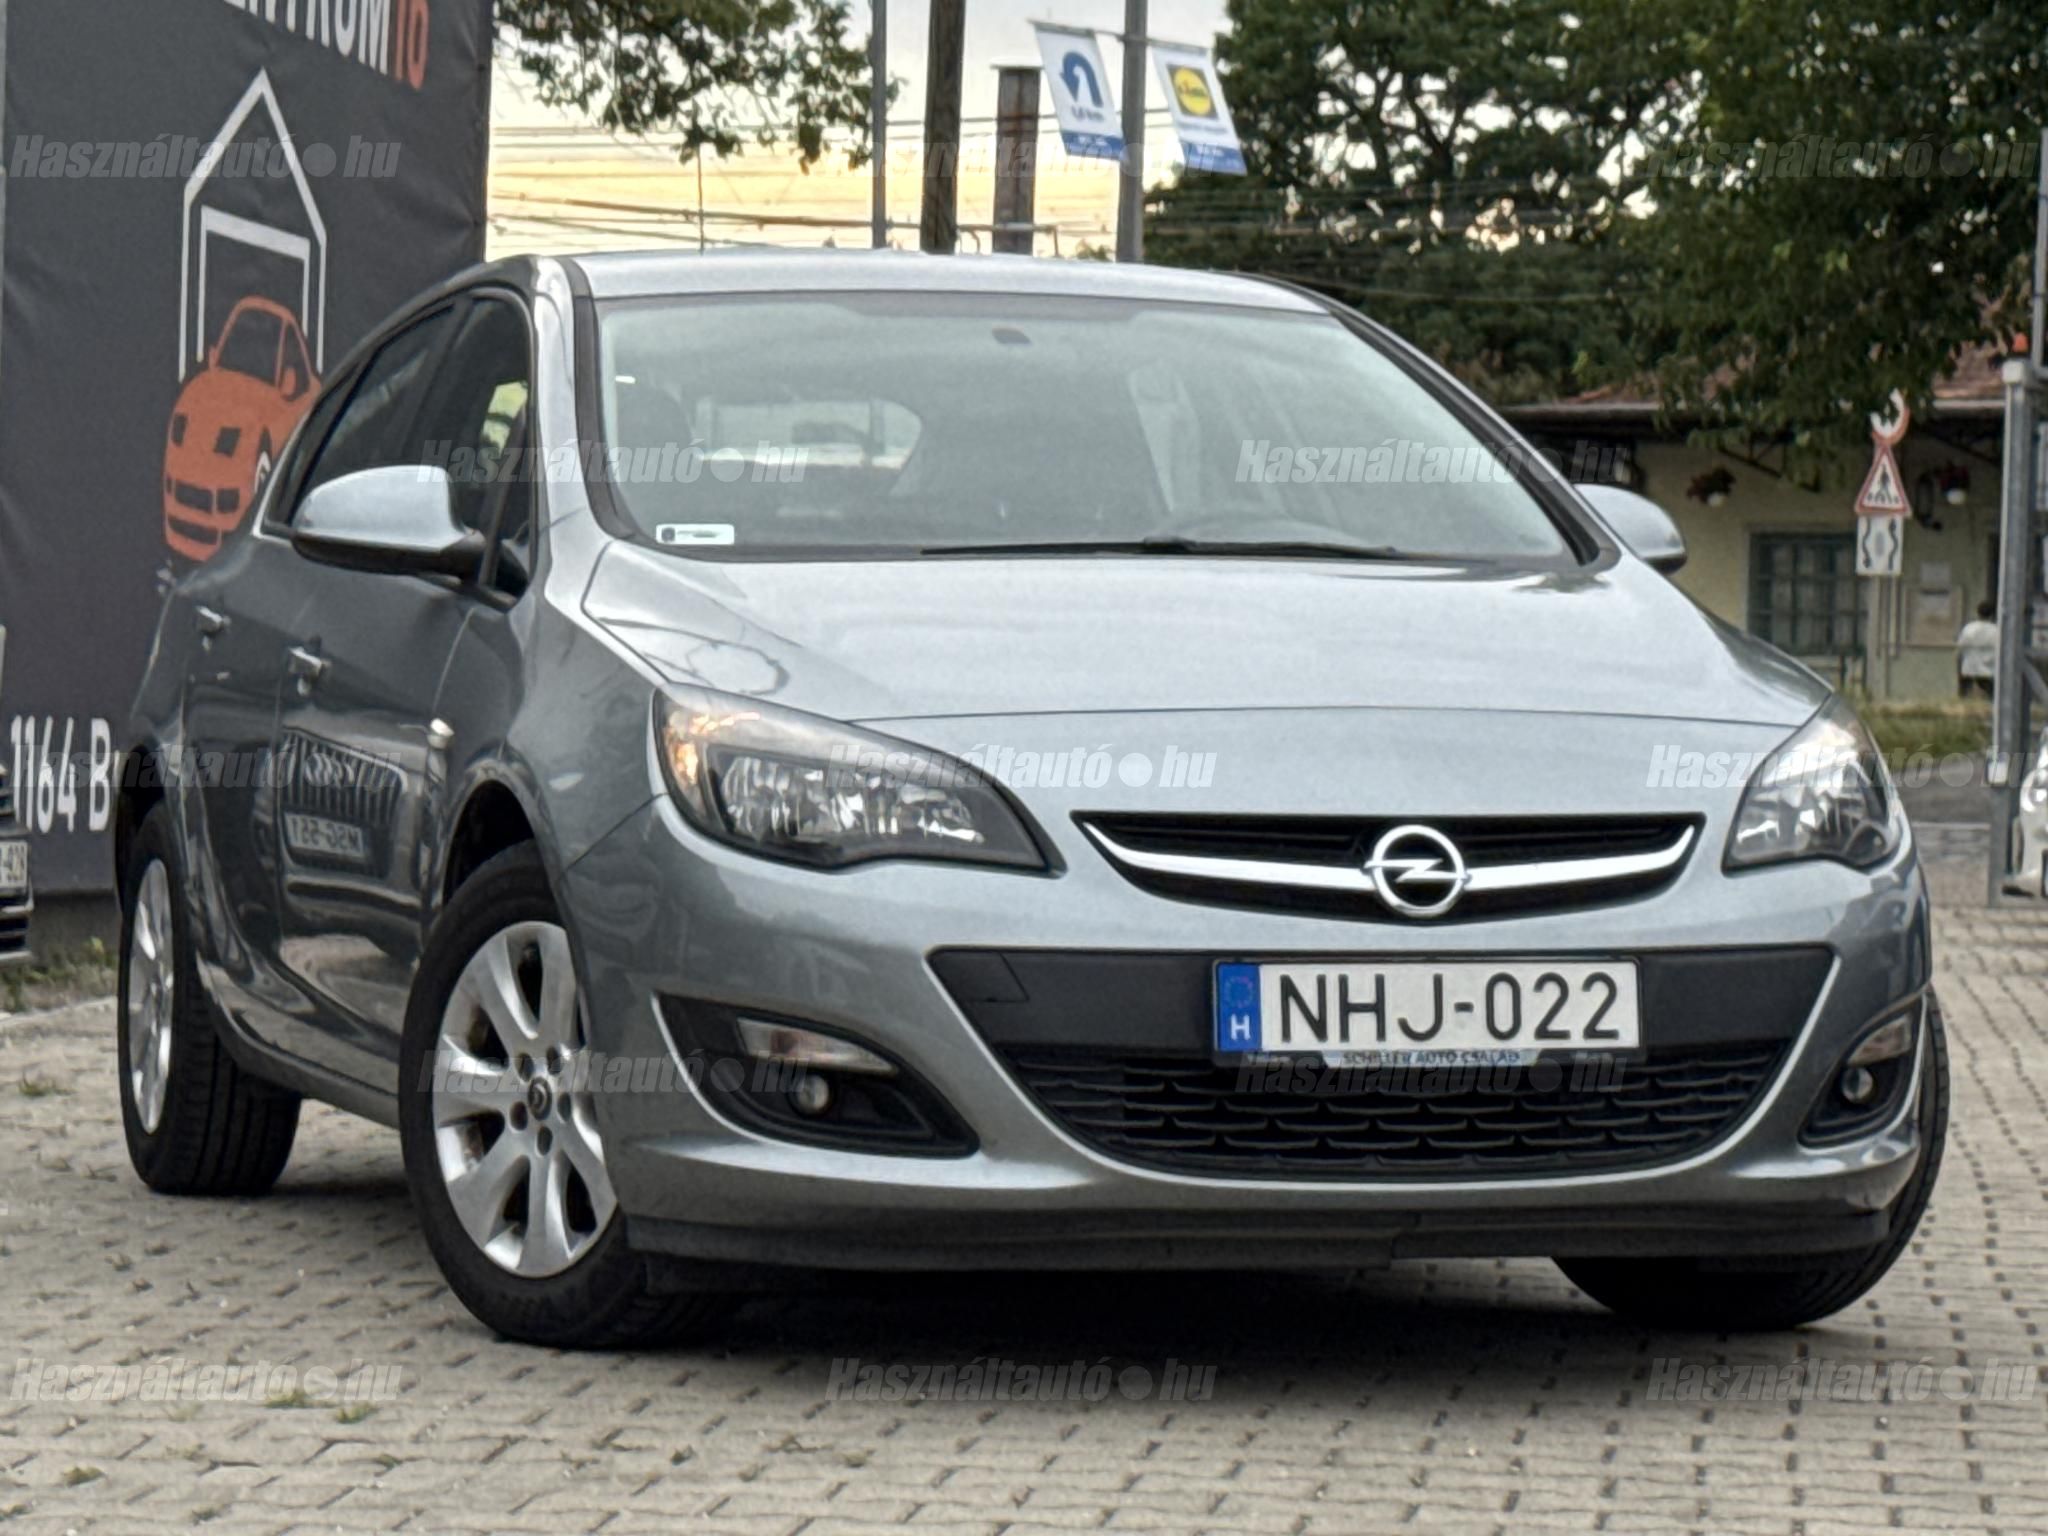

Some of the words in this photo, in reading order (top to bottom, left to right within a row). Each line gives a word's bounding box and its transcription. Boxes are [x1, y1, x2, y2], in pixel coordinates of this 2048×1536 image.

[10, 714, 77, 833] 1164
[1231, 1014, 1251, 1040] H
[1280, 972, 1619, 1042] NHJ-022
